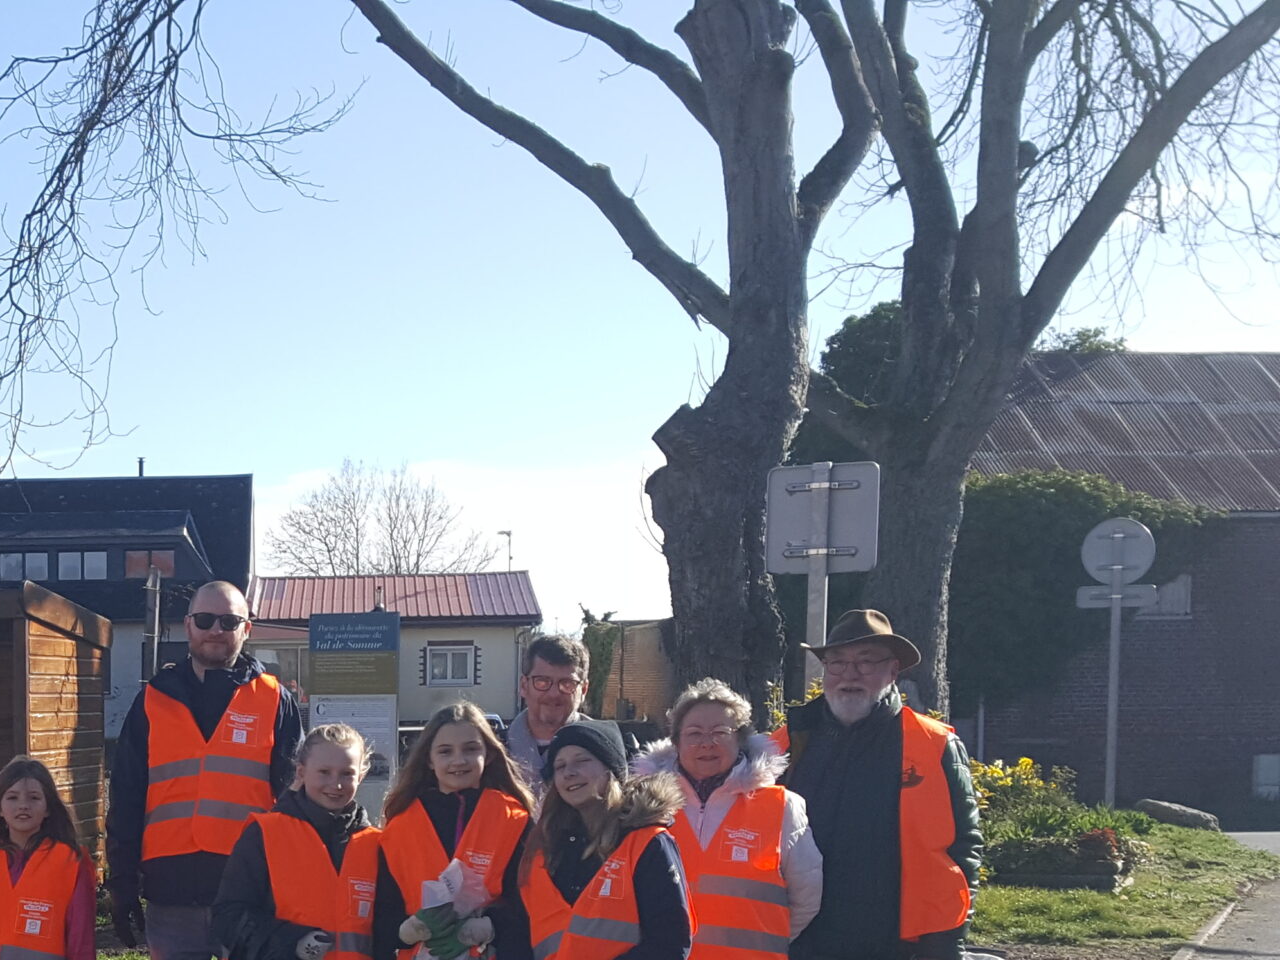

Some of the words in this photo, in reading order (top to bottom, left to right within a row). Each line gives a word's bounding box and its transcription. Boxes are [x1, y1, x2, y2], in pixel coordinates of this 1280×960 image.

[316, 640, 332, 649] Val
[332, 640, 344, 649] de
[346, 640, 383, 649] Somme
